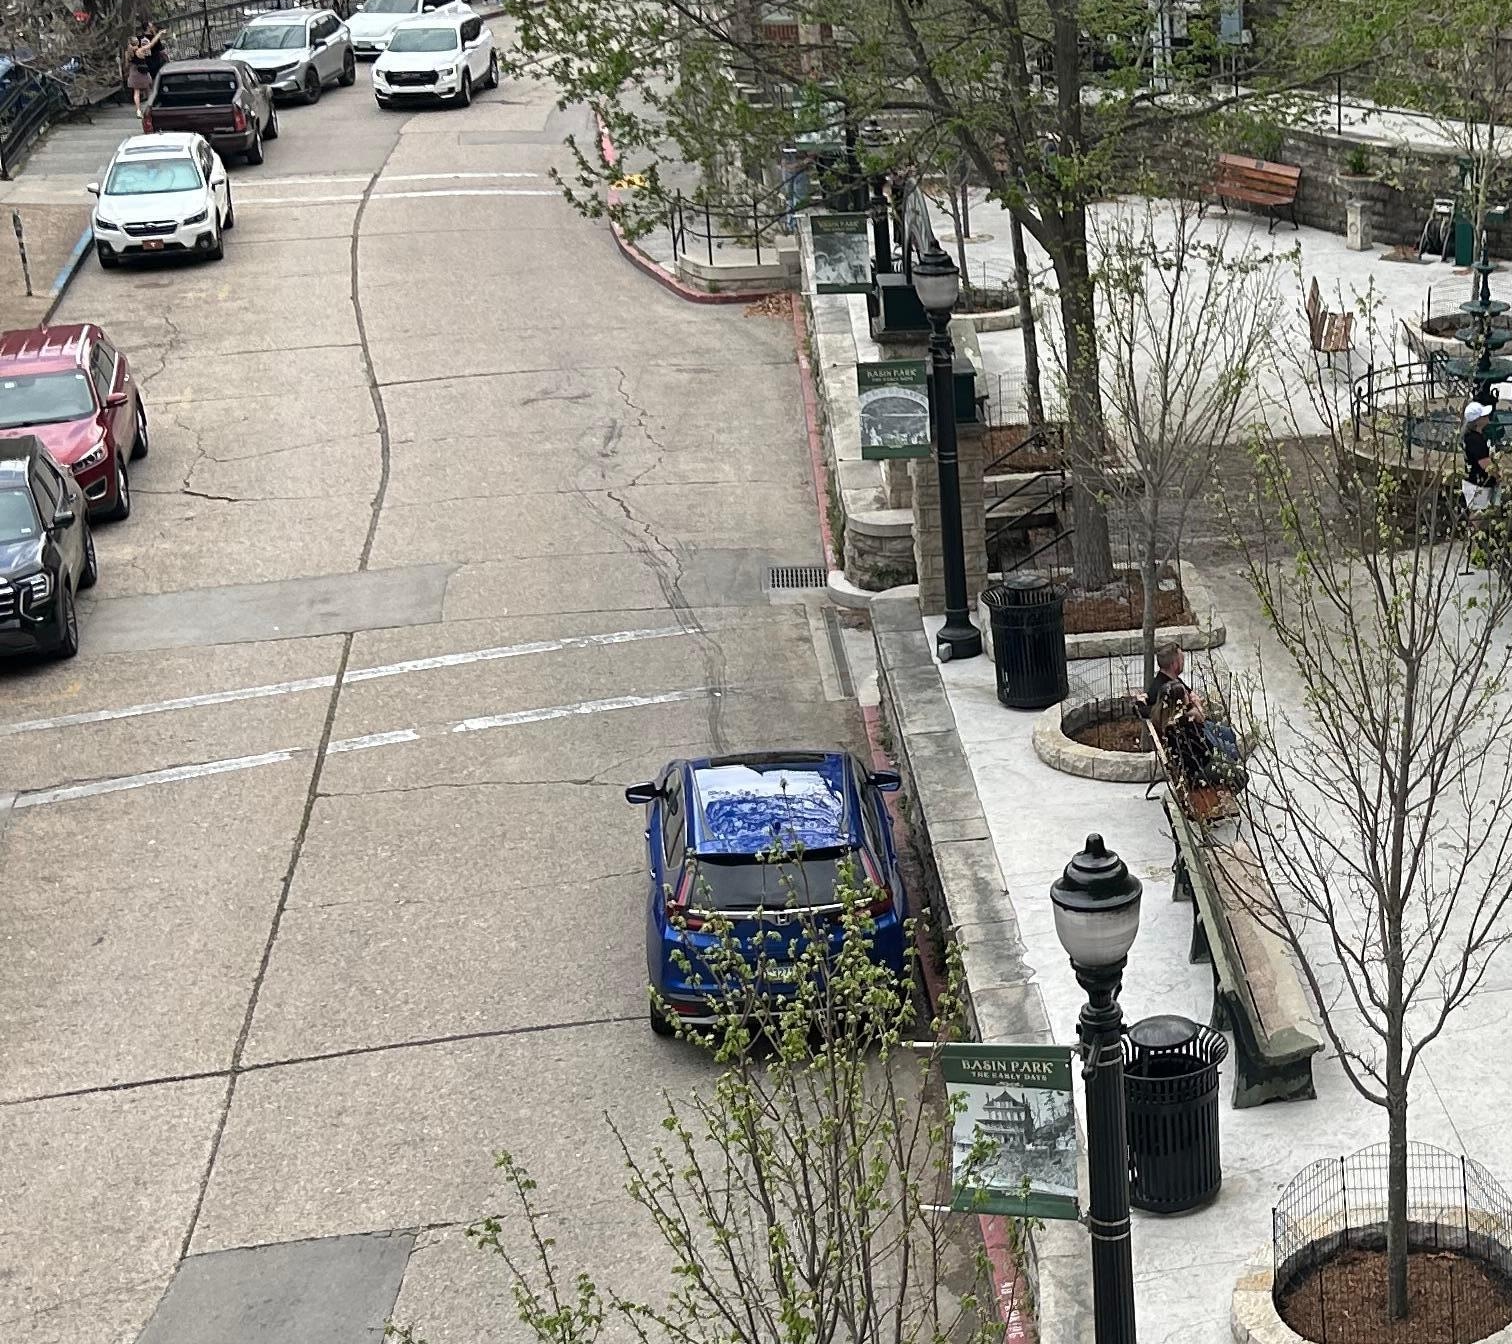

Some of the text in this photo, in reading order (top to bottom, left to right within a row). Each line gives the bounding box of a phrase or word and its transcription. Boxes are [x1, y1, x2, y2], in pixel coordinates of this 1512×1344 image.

[961, 1059, 1054, 1074] BASIN PARK
[972, 1071, 990, 1079] THE
